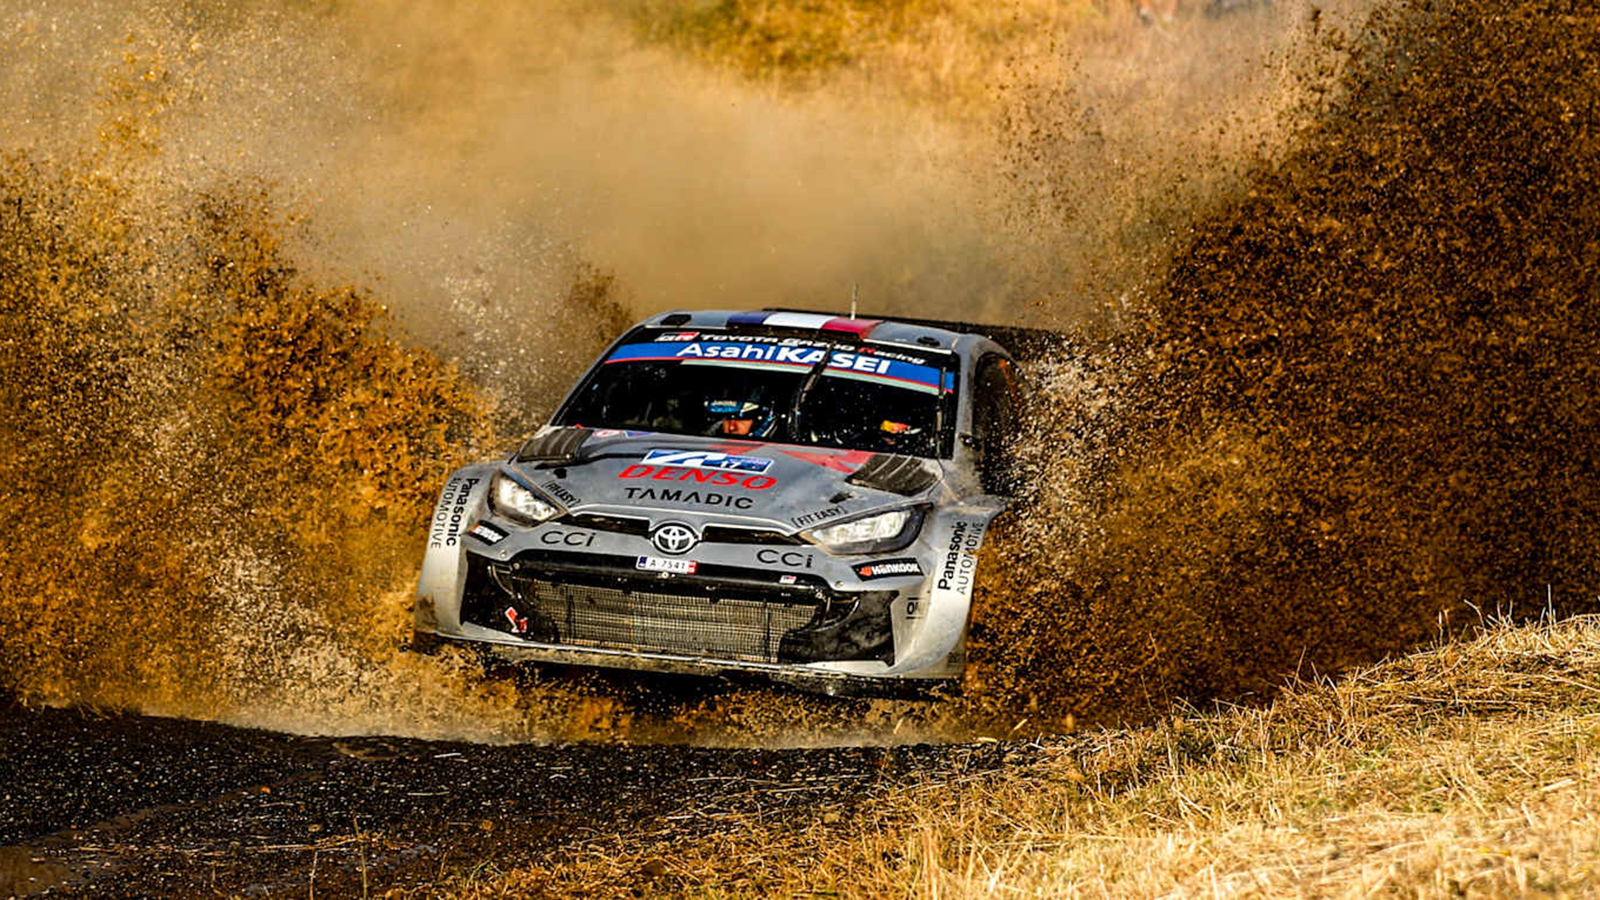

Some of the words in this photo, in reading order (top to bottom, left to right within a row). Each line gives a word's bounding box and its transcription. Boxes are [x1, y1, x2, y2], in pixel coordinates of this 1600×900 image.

[701, 334, 778, 344] TOYOTA
[618, 465, 778, 490] DENSO
[624, 487, 754, 510] TAMADIC
[446, 478, 480, 546] Panasonic
[938, 521, 967, 591] Panasonic
